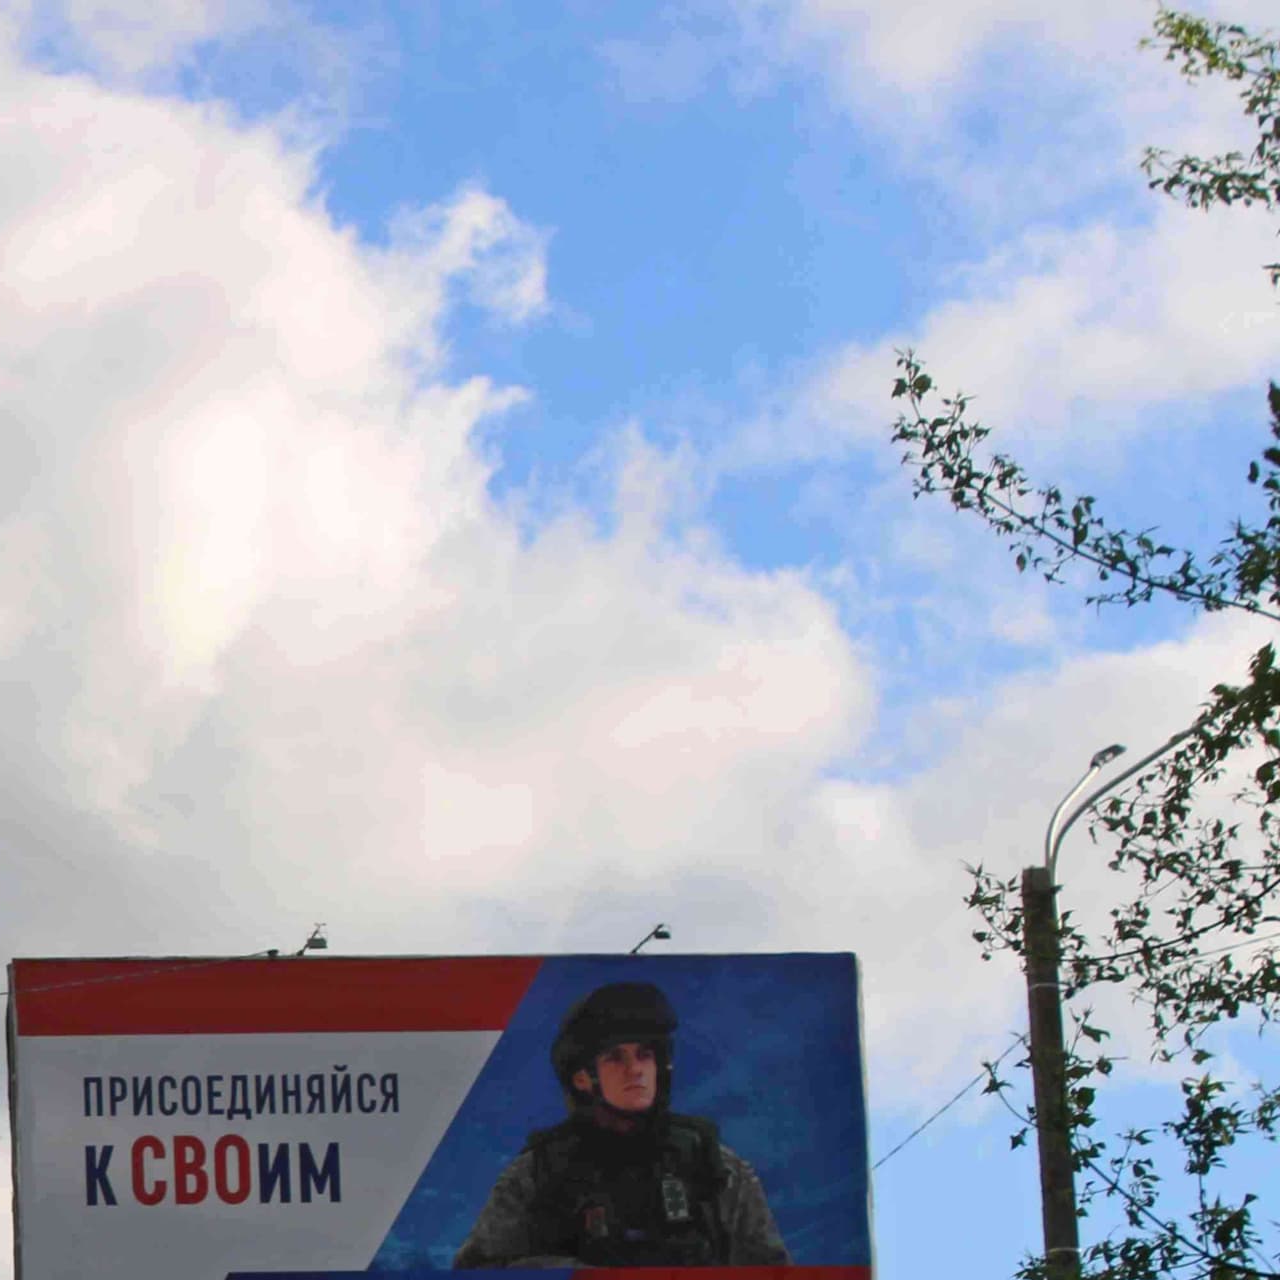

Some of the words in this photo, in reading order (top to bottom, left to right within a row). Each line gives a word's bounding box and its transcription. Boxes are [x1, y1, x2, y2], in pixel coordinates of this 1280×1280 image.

[82, 1064, 400, 1121] ПРИСОЕДИНЯЙСЯ
[85, 1144, 118, 1207] К
[130, 1133, 342, 1207] СВОИМ
